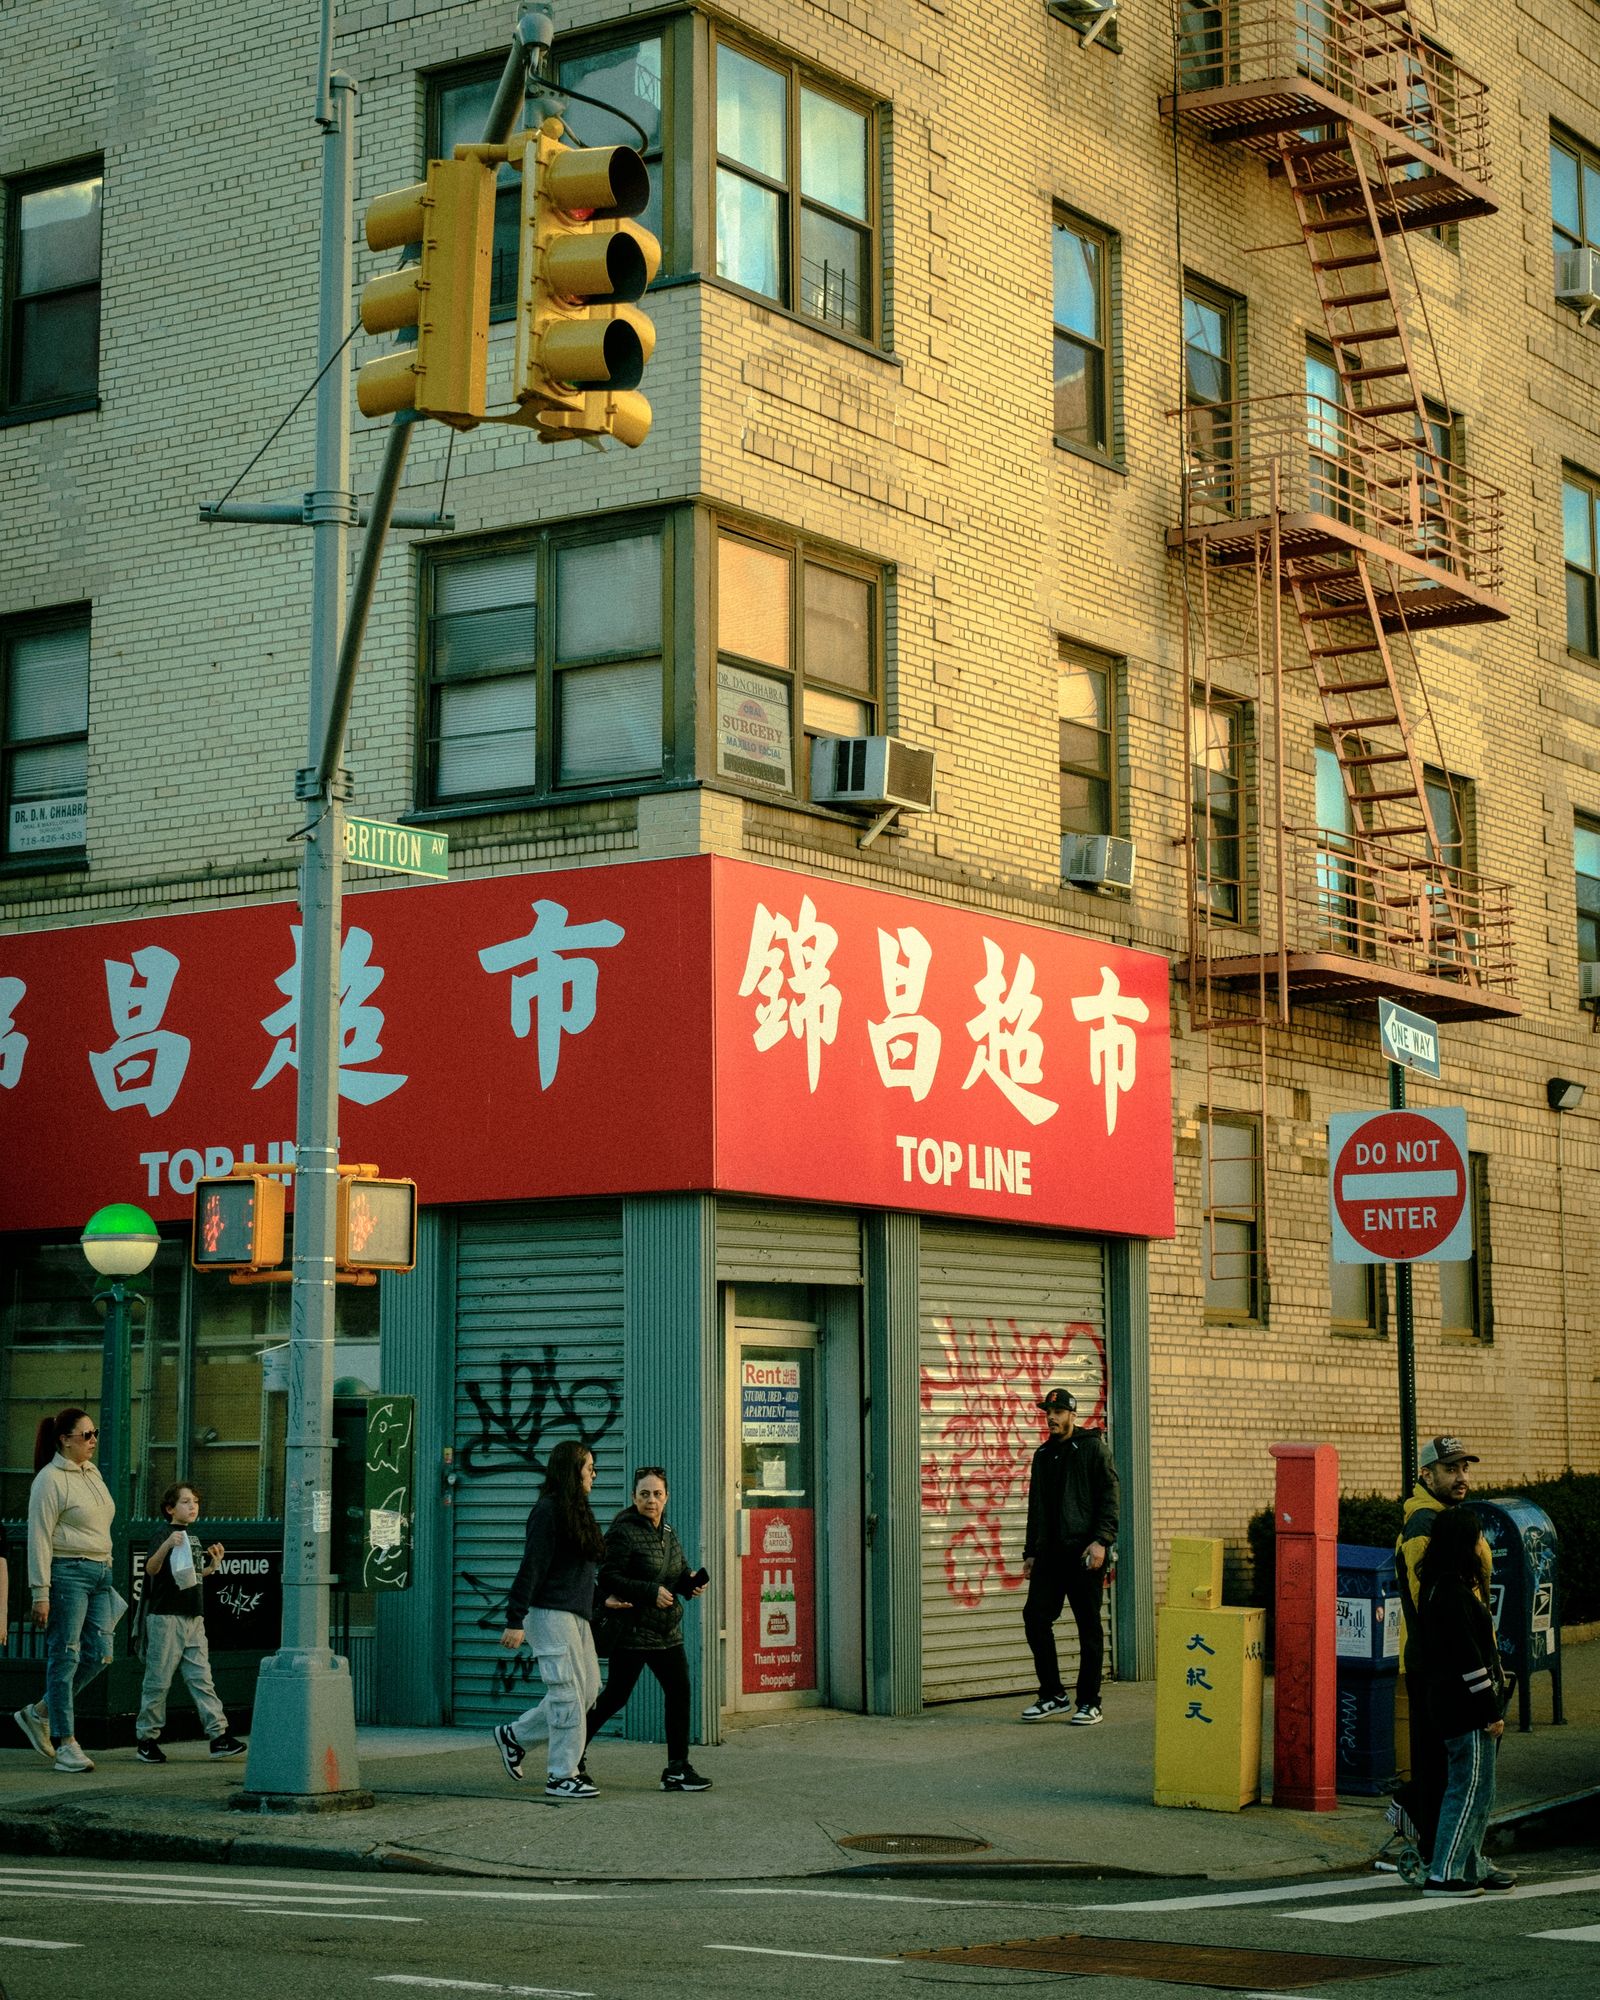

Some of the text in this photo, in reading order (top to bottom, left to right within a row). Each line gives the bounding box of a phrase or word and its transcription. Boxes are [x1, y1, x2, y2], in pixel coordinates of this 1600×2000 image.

[722, 715, 783, 743] SURGERY
[15, 810, 28, 823] DR.
[50, 802, 87, 819] CHHABRA
[20, 832, 83, 846] 718-426-4353
[346, 822, 445, 868] BRITTON AV
[0, 899, 625, 1117] 昌超市
[738, 894, 1149, 1136] 錦昌超市
[1391, 1022, 1430, 1057] ONE WAY
[896, 1135, 1032, 1196] TOP LINE
[1356, 1139, 1441, 1166] DO NOT
[139, 1146, 235, 1197] TOP
[1363, 1206, 1438, 1231] ENTER
[745, 1363, 781, 1384] Rent
[743, 1404, 786, 1418] APARTMENT
[769, 1531, 788, 1539] STELLA
[212, 1558, 270, 1576] Avenue
[753, 1651, 802, 1667] Thank you for
[1185, 1633, 1216, 1724] 大紀元
